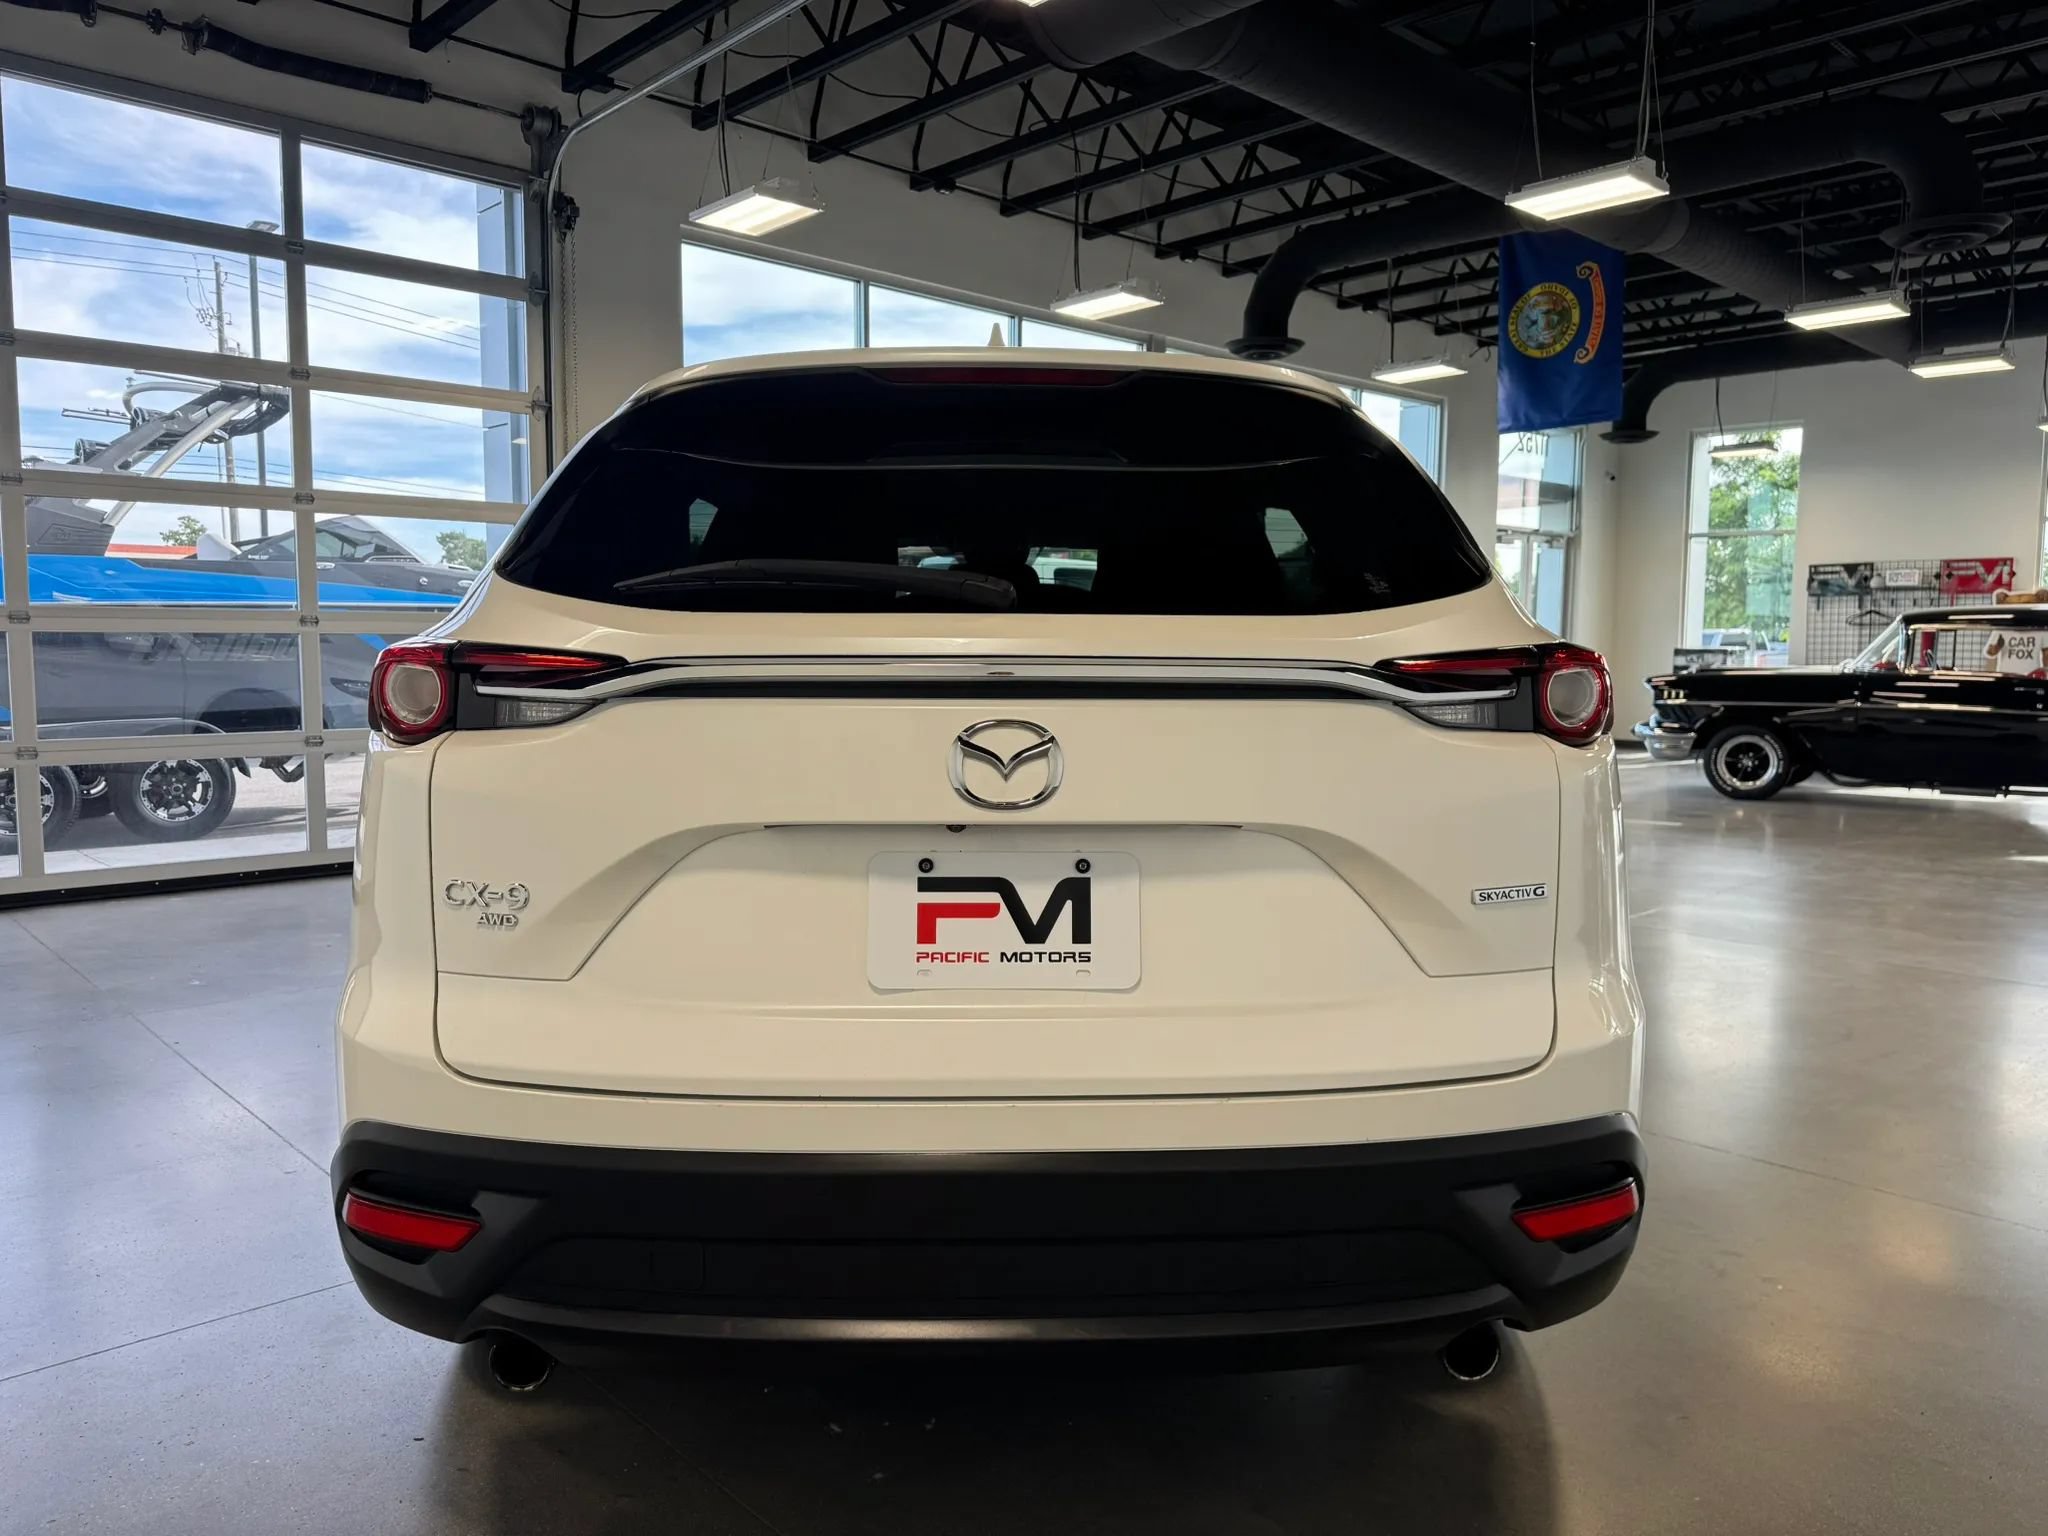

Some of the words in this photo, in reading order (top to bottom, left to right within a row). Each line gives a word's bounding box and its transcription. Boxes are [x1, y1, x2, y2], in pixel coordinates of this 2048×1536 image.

[2008, 636, 2035, 648] CAR
[2008, 648, 2033, 660] FOX
[444, 878, 530, 911] CX-9
[917, 877, 1092, 945] PM
[477, 912, 520, 928] AWD
[916, 951, 990, 963] PACIFIC
[1000, 951, 1092, 963] MOTORS
